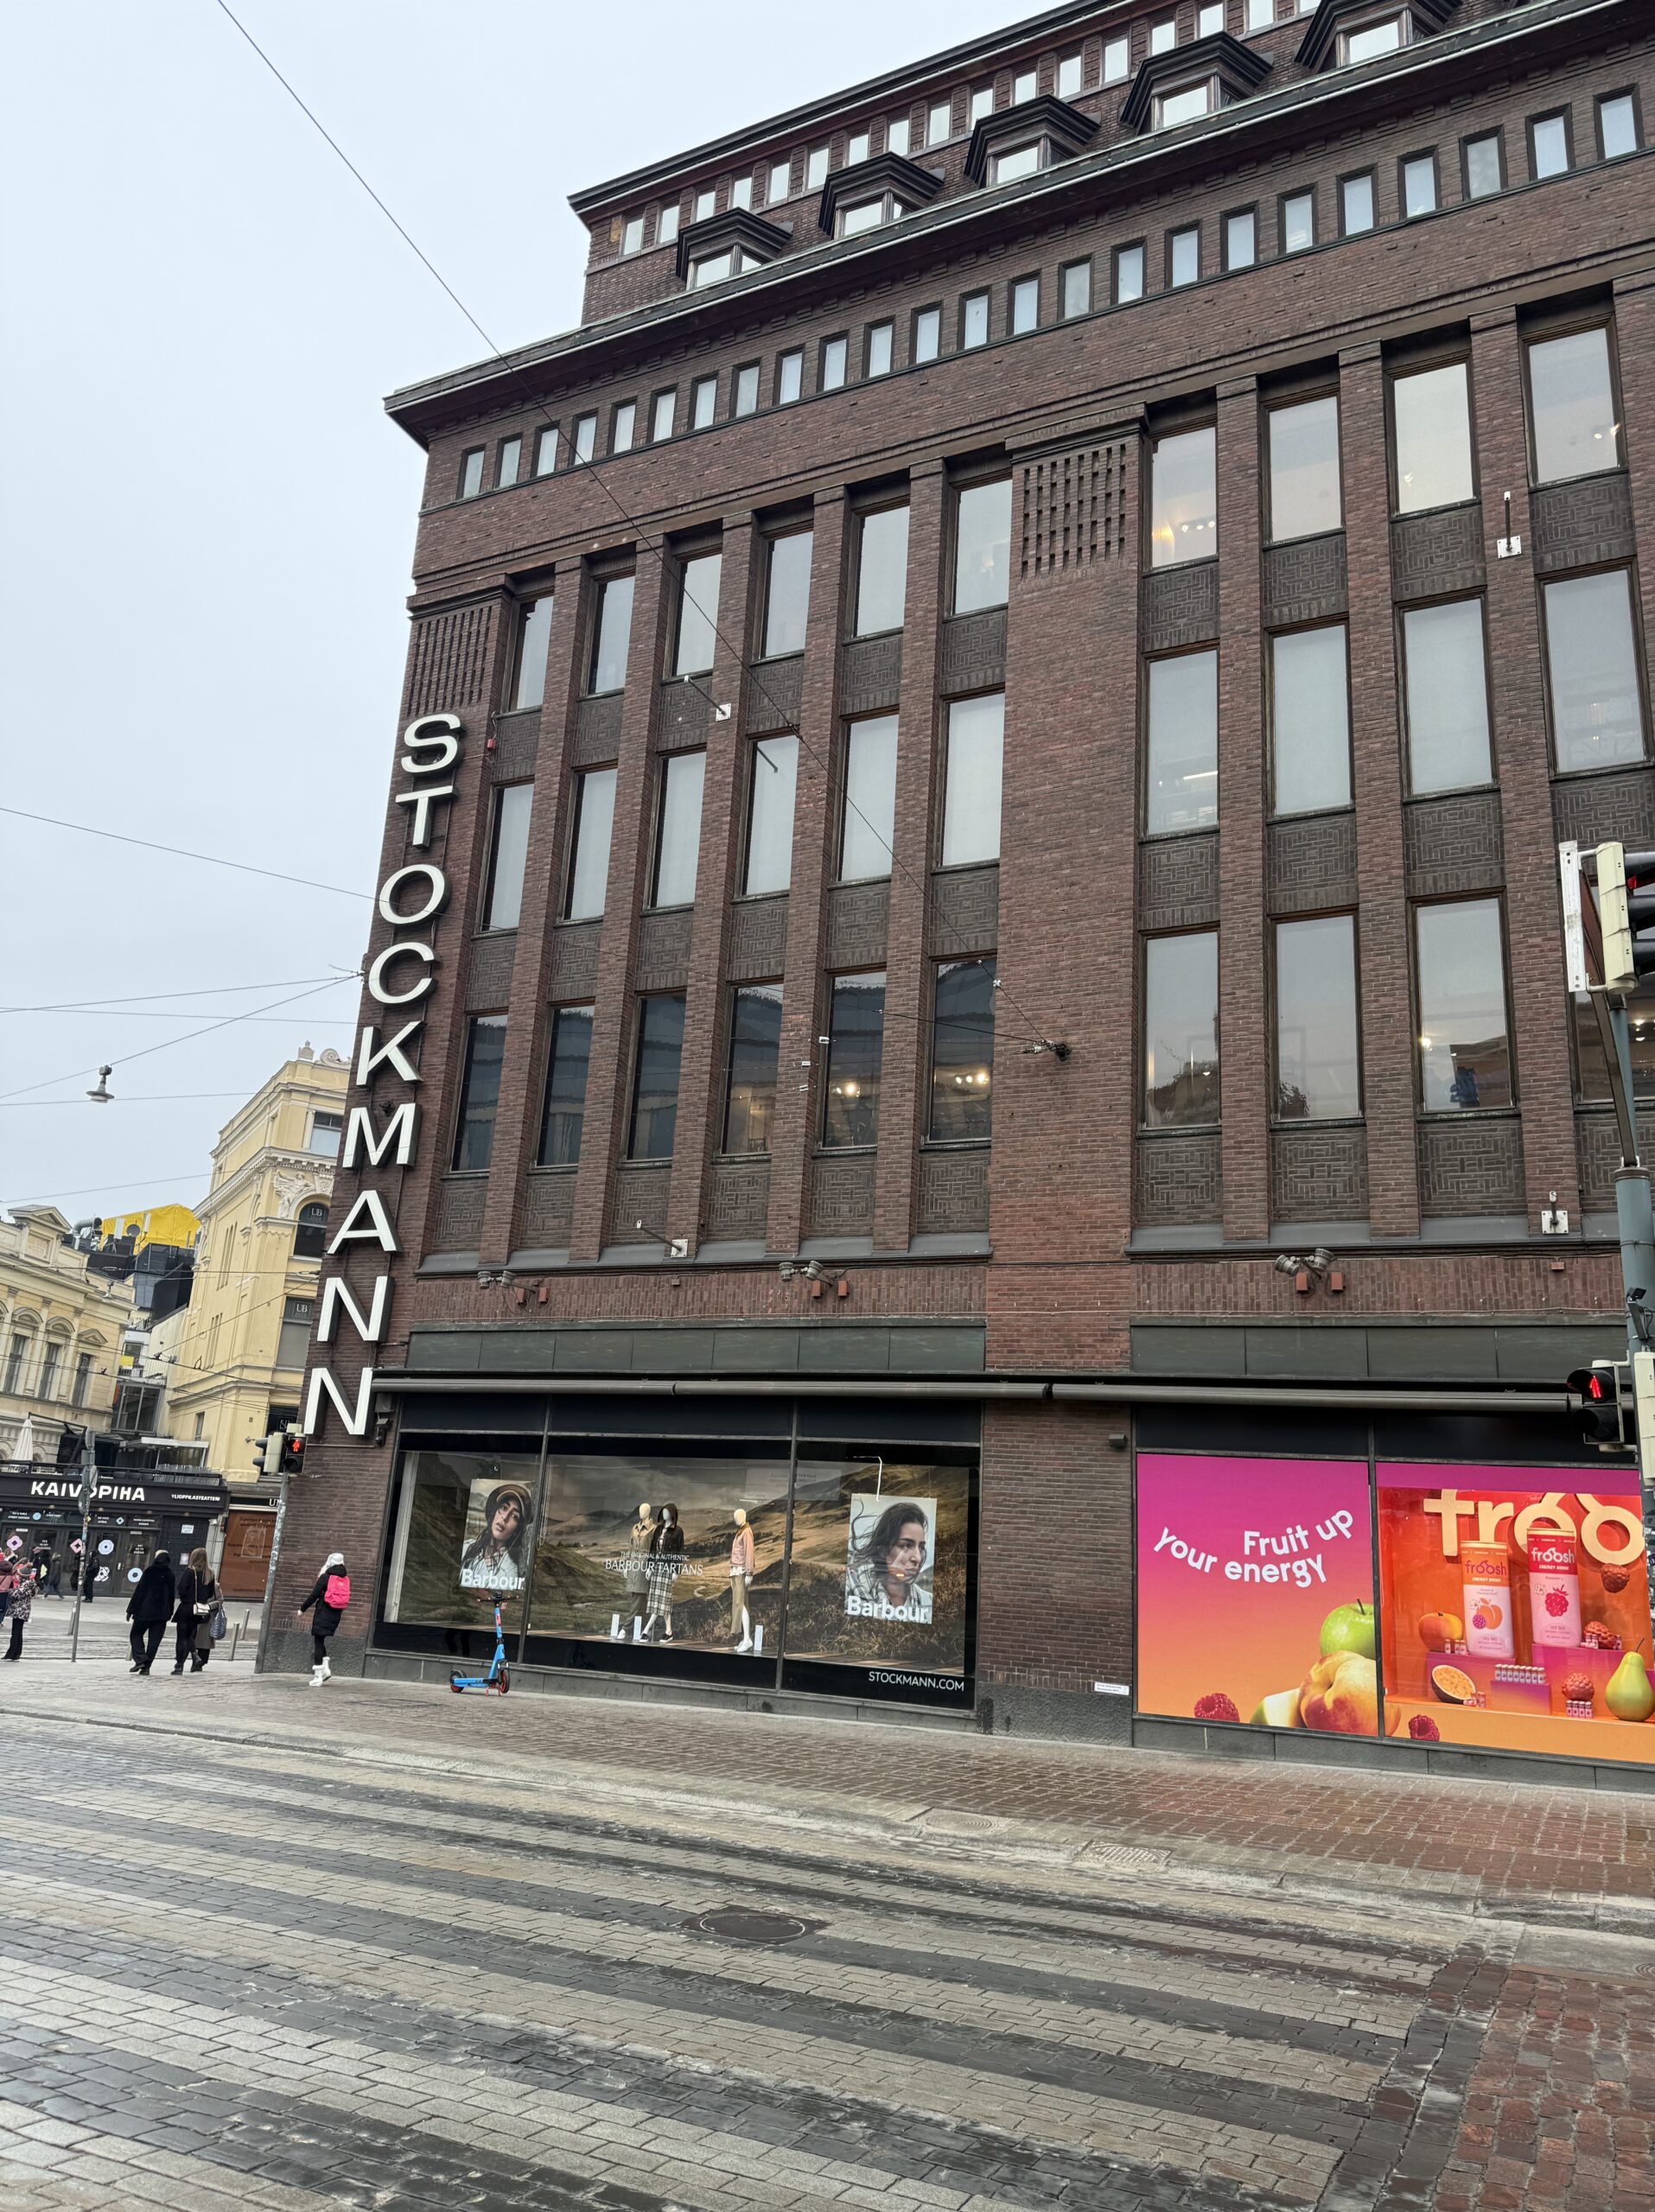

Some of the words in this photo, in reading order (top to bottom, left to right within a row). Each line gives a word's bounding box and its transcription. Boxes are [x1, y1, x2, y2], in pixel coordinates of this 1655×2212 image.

[303, 713, 463, 1436] STOCKMANN
[1244, 1524, 1309, 1556] Fruit
[1315, 1510, 1353, 1540] up
[1153, 1527, 1218, 1573] your
[1225, 1554, 1327, 1588] energy
[1531, 1547, 1575, 1563] froosh
[605, 1559, 654, 1573] BARBOUR
[657, 1562, 703, 1576] TARTANS
[1465, 1560, 1507, 1575] froosh
[869, 1671, 964, 1692] STOCKMANN.COM
